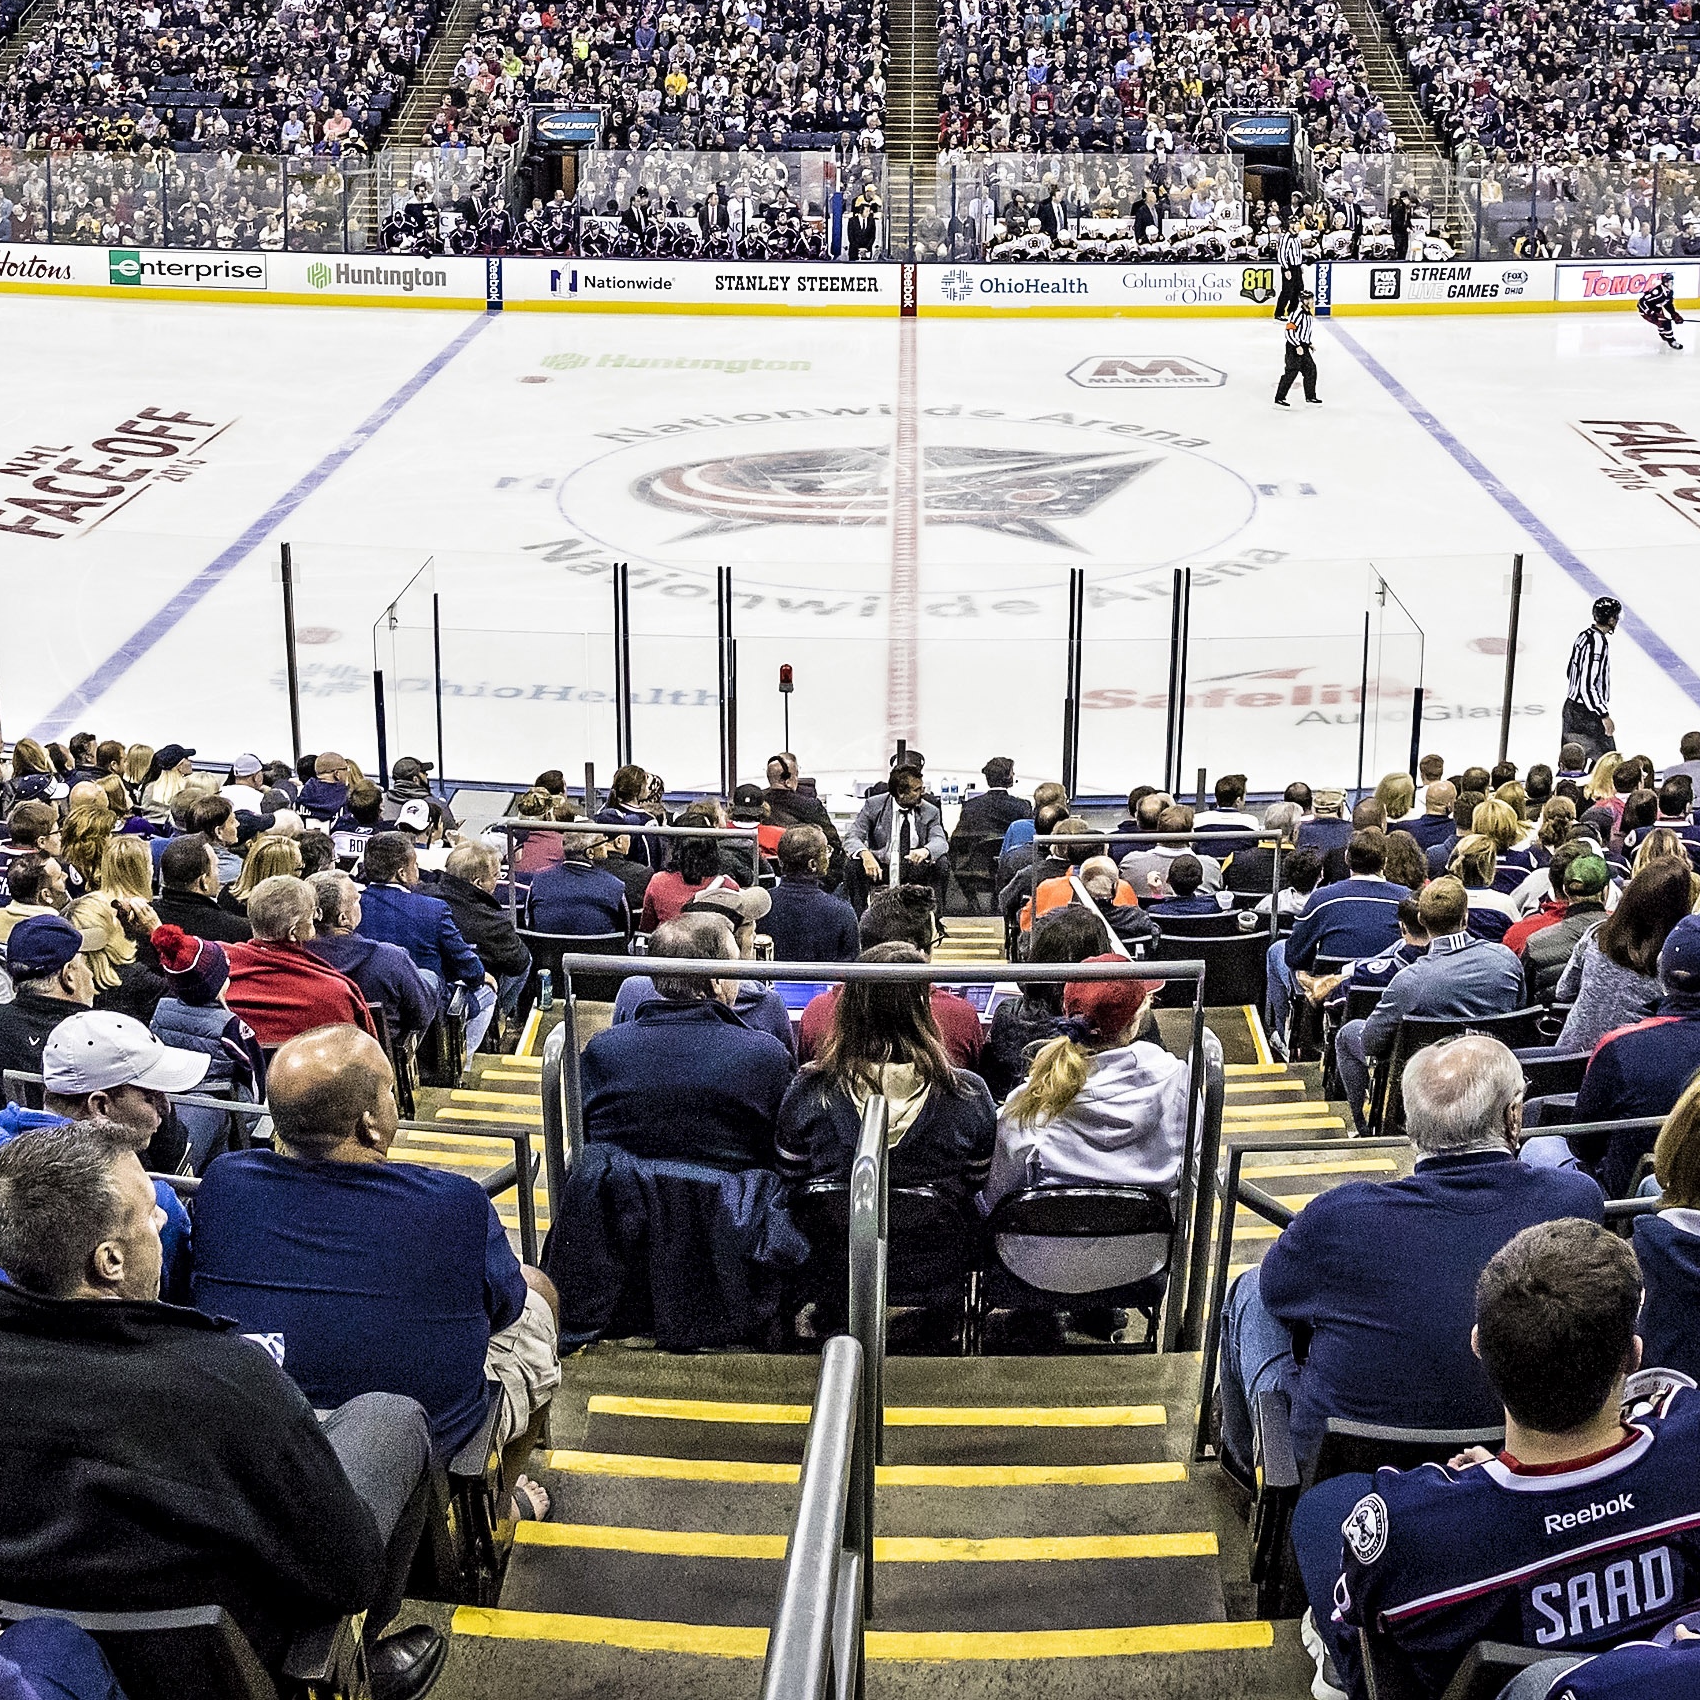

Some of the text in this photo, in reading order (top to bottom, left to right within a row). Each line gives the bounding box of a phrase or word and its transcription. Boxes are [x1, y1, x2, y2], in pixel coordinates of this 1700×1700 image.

[118, 258, 263, 282] enterprise
[335, 262, 447, 292] Huntington
[489, 259, 500, 300] Reebok
[1122, 272, 1232, 288] Columbia Gas
[1242, 268, 1274, 290] 811
[1410, 267, 1471, 281] STREAM
[1507, 271, 1523, 280] FOX
[584, 275, 673, 290] Nationwide
[715, 276, 879, 293] STANLEY STEEMER
[903, 263, 914, 308] Reebok
[979, 278, 1089, 294] OhioHealth
[1318, 265, 1329, 306] Reebok
[1374, 285, 1396, 297] GO
[1447, 284, 1499, 298] GAMES
[1504, 287, 1524, 295] OHIO
[1165, 288, 1222, 304] of Ohio
[596, 353, 813, 374] Huntington
[1088, 377, 1211, 385] MARATHON
[594, 403, 1211, 450] Nationwide Arena
[152, 458, 208, 483] 2016
[1599, 467, 1658, 491] 2016
[385, 676, 721, 707] OhioHealth
[1544, 1493, 1635, 1535] Reebok
[1532, 1545, 1674, 1644] SAAD
